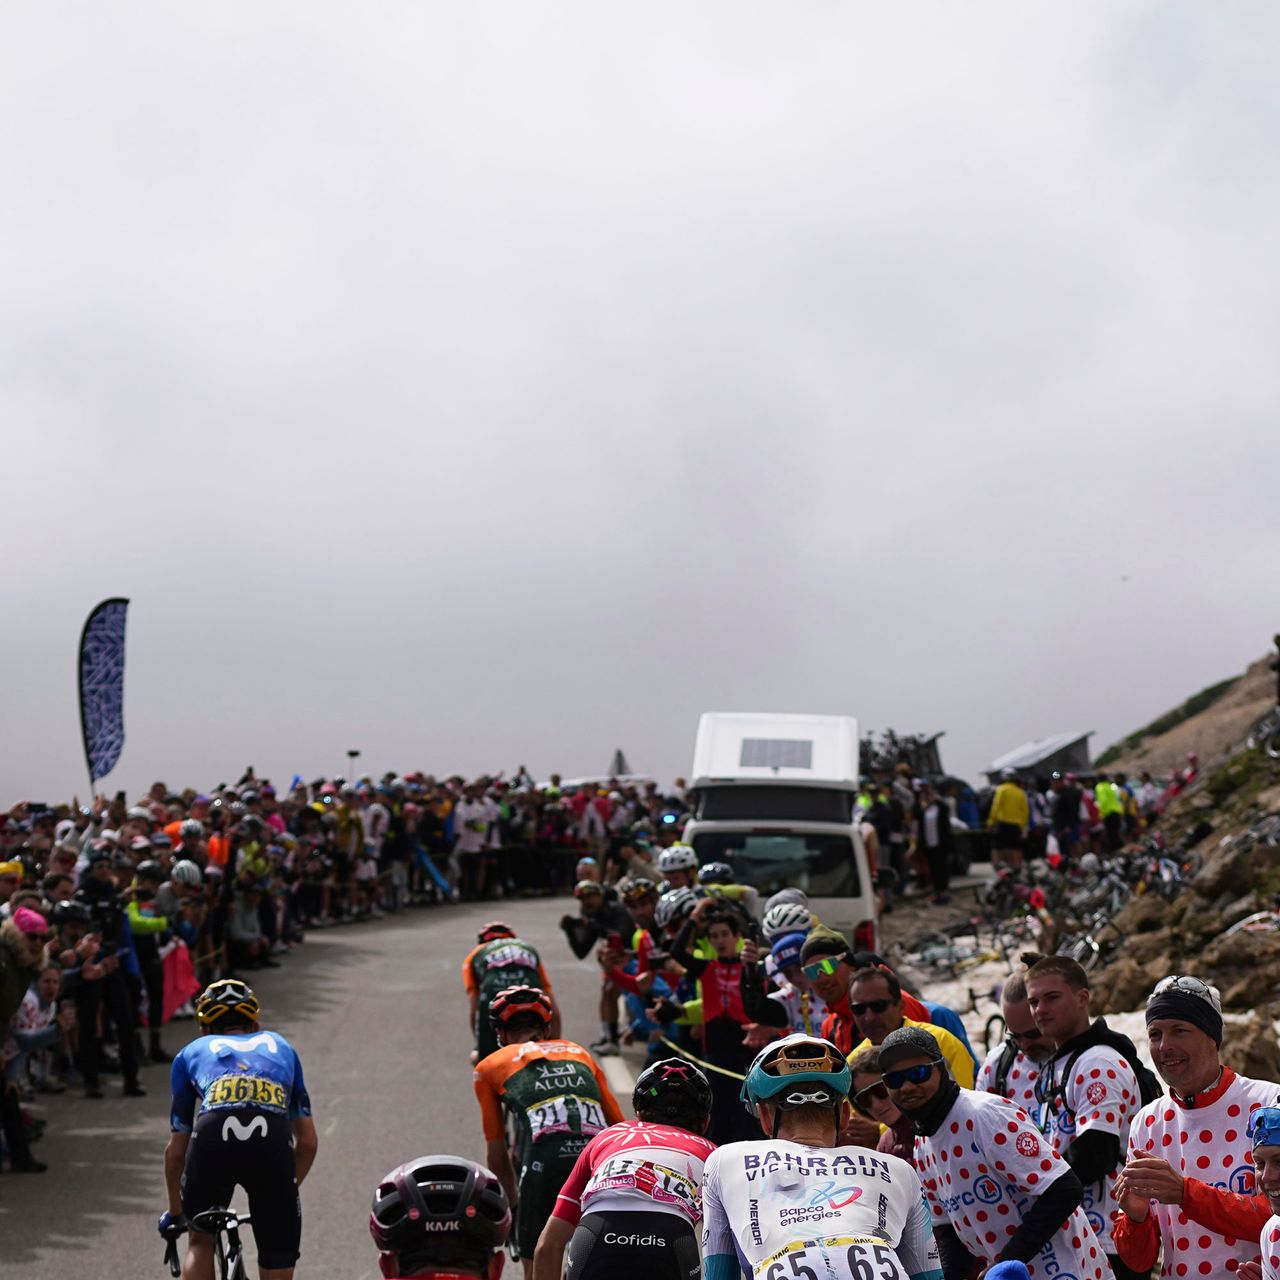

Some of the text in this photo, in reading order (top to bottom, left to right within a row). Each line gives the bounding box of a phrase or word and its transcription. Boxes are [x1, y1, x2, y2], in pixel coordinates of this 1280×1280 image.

[788, 1061, 825, 1069] RUDY
[535, 1075, 586, 1091] ALULA
[744, 1151, 890, 1172] BAHRAIN
[746, 1162, 891, 1184] VICTORIOUS
[779, 1205, 825, 1218] Bapco
[780, 1210, 842, 1227] energies
[749, 1199, 762, 1246] MERIDA
[604, 1232, 666, 1247] Cofidis
[772, 1247, 790, 1262] HAIG
